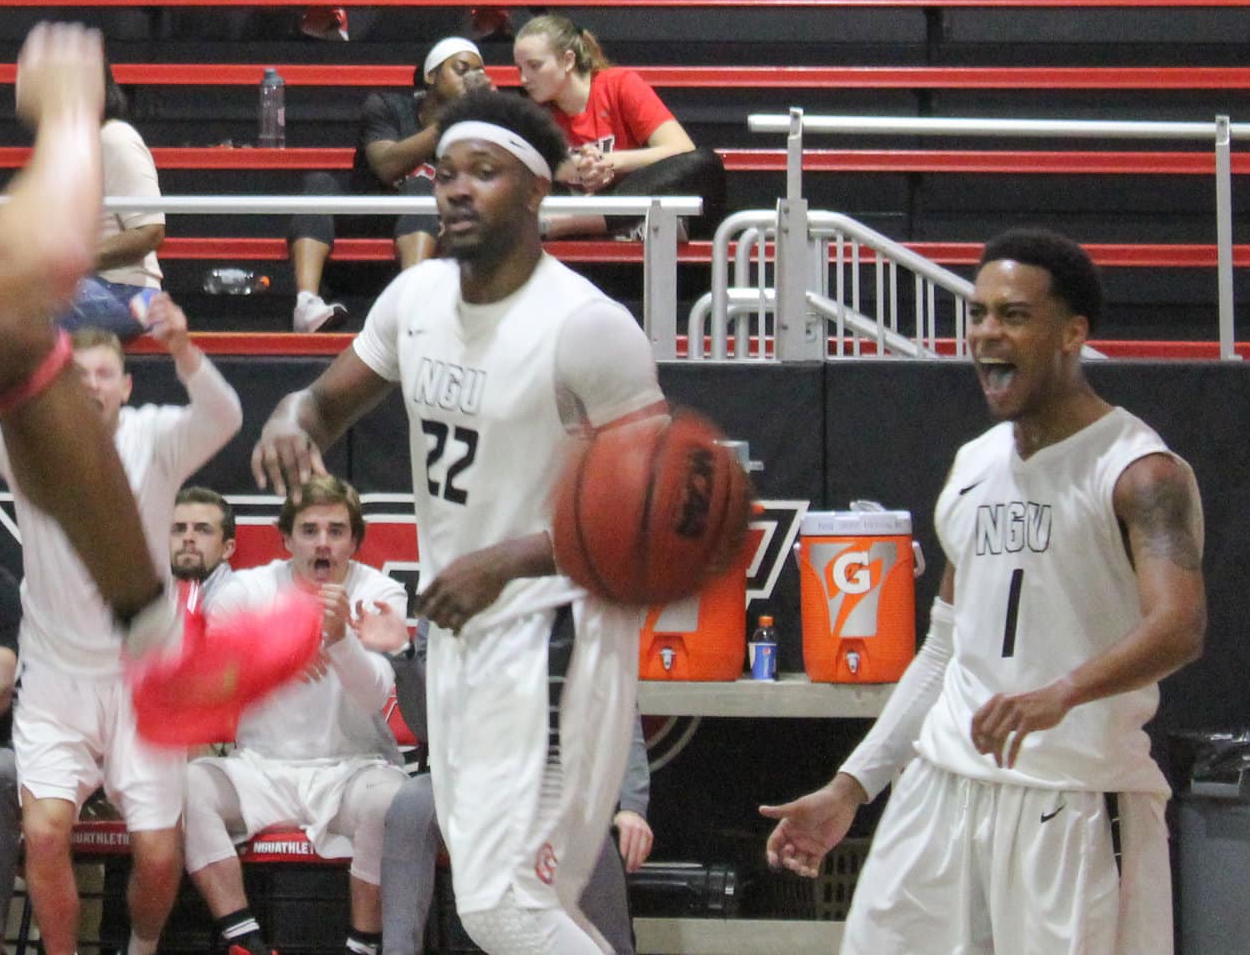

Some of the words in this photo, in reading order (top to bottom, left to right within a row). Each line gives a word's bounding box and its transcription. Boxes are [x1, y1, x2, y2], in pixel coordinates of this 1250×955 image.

[414, 357, 487, 415] NGU
[421, 418, 479, 506] 22
[976, 501, 1052, 556] NGU
[833, 551, 871, 594] G
[1001, 568, 1024, 657] 1
